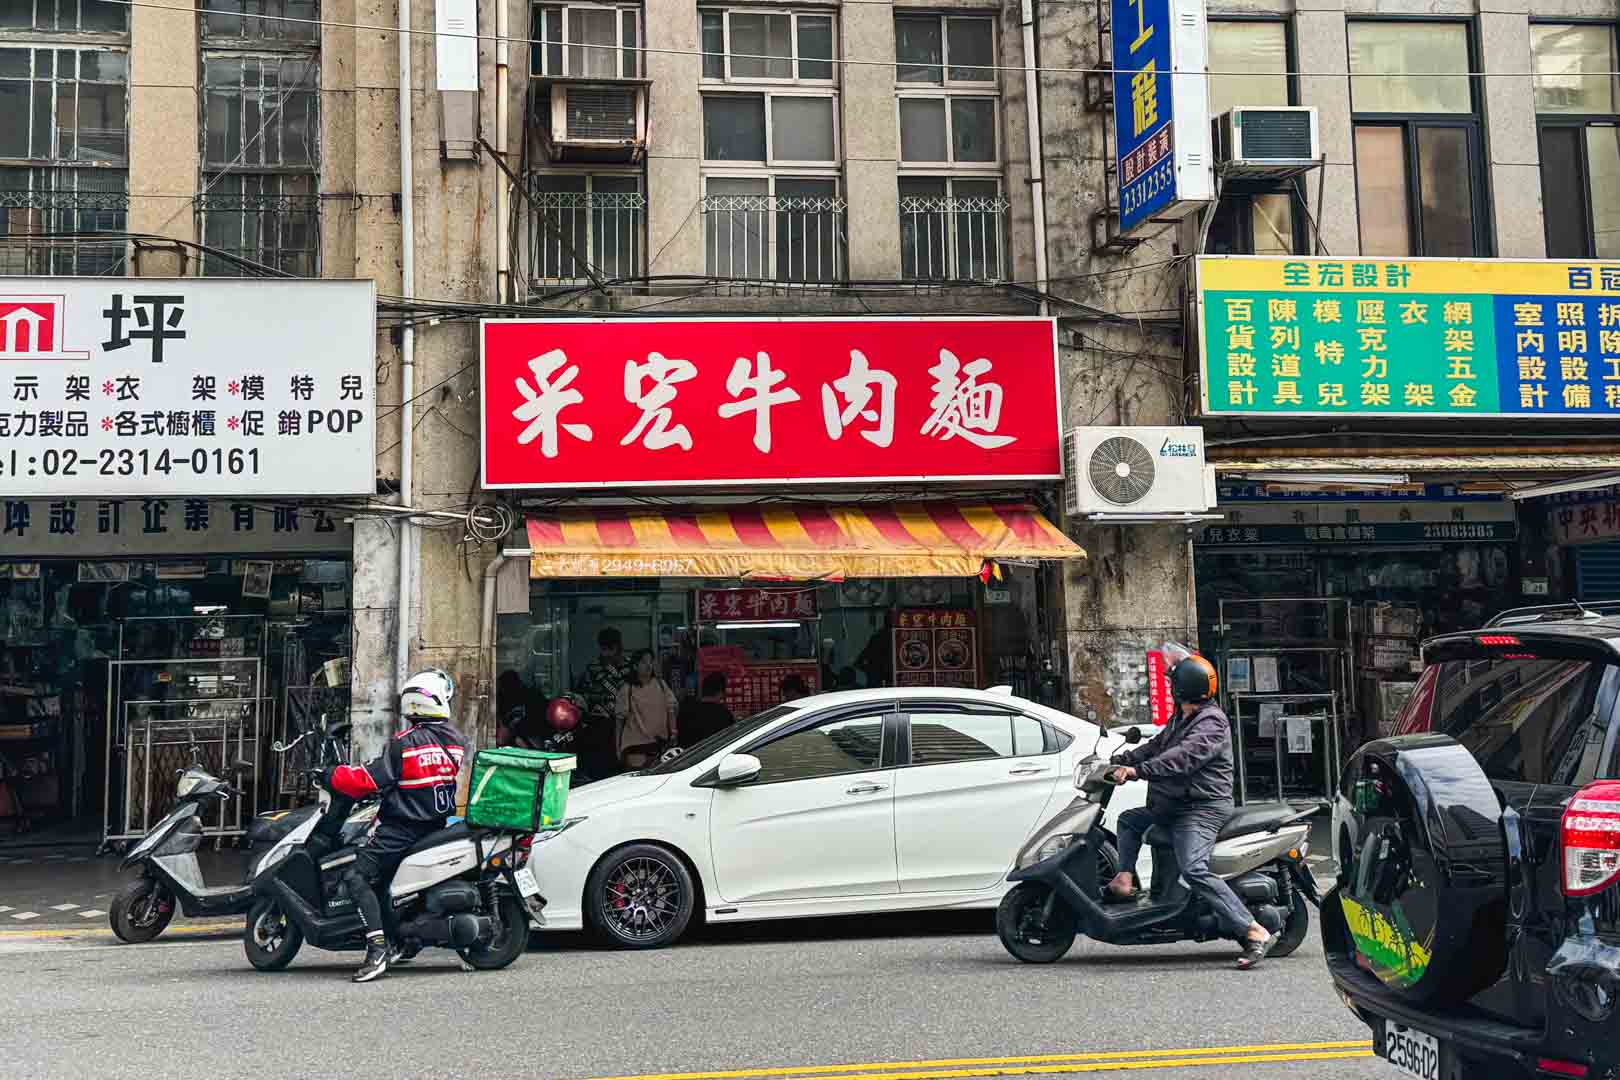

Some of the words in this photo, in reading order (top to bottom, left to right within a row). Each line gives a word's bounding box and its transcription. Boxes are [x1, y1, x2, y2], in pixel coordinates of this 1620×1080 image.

[1129, 0, 1158, 138] 工程
[1124, 160, 1172, 216] 23312355
[101, 294, 187, 363] 坪
[1283, 263, 1411, 288] 全宏設計
[511, 347, 1018, 458] 采宏牛肉麵
[1224, 298, 1258, 405] 百貨設計
[1267, 299, 1303, 405] 陳列道具
[1313, 299, 1347, 407] 模特兒
[1400, 300, 1435, 407] 衣架
[1443, 300, 1477, 407] 網架五金
[1513, 302, 1549, 408] 室內設計
[1556, 302, 1592, 408] 照明設備
